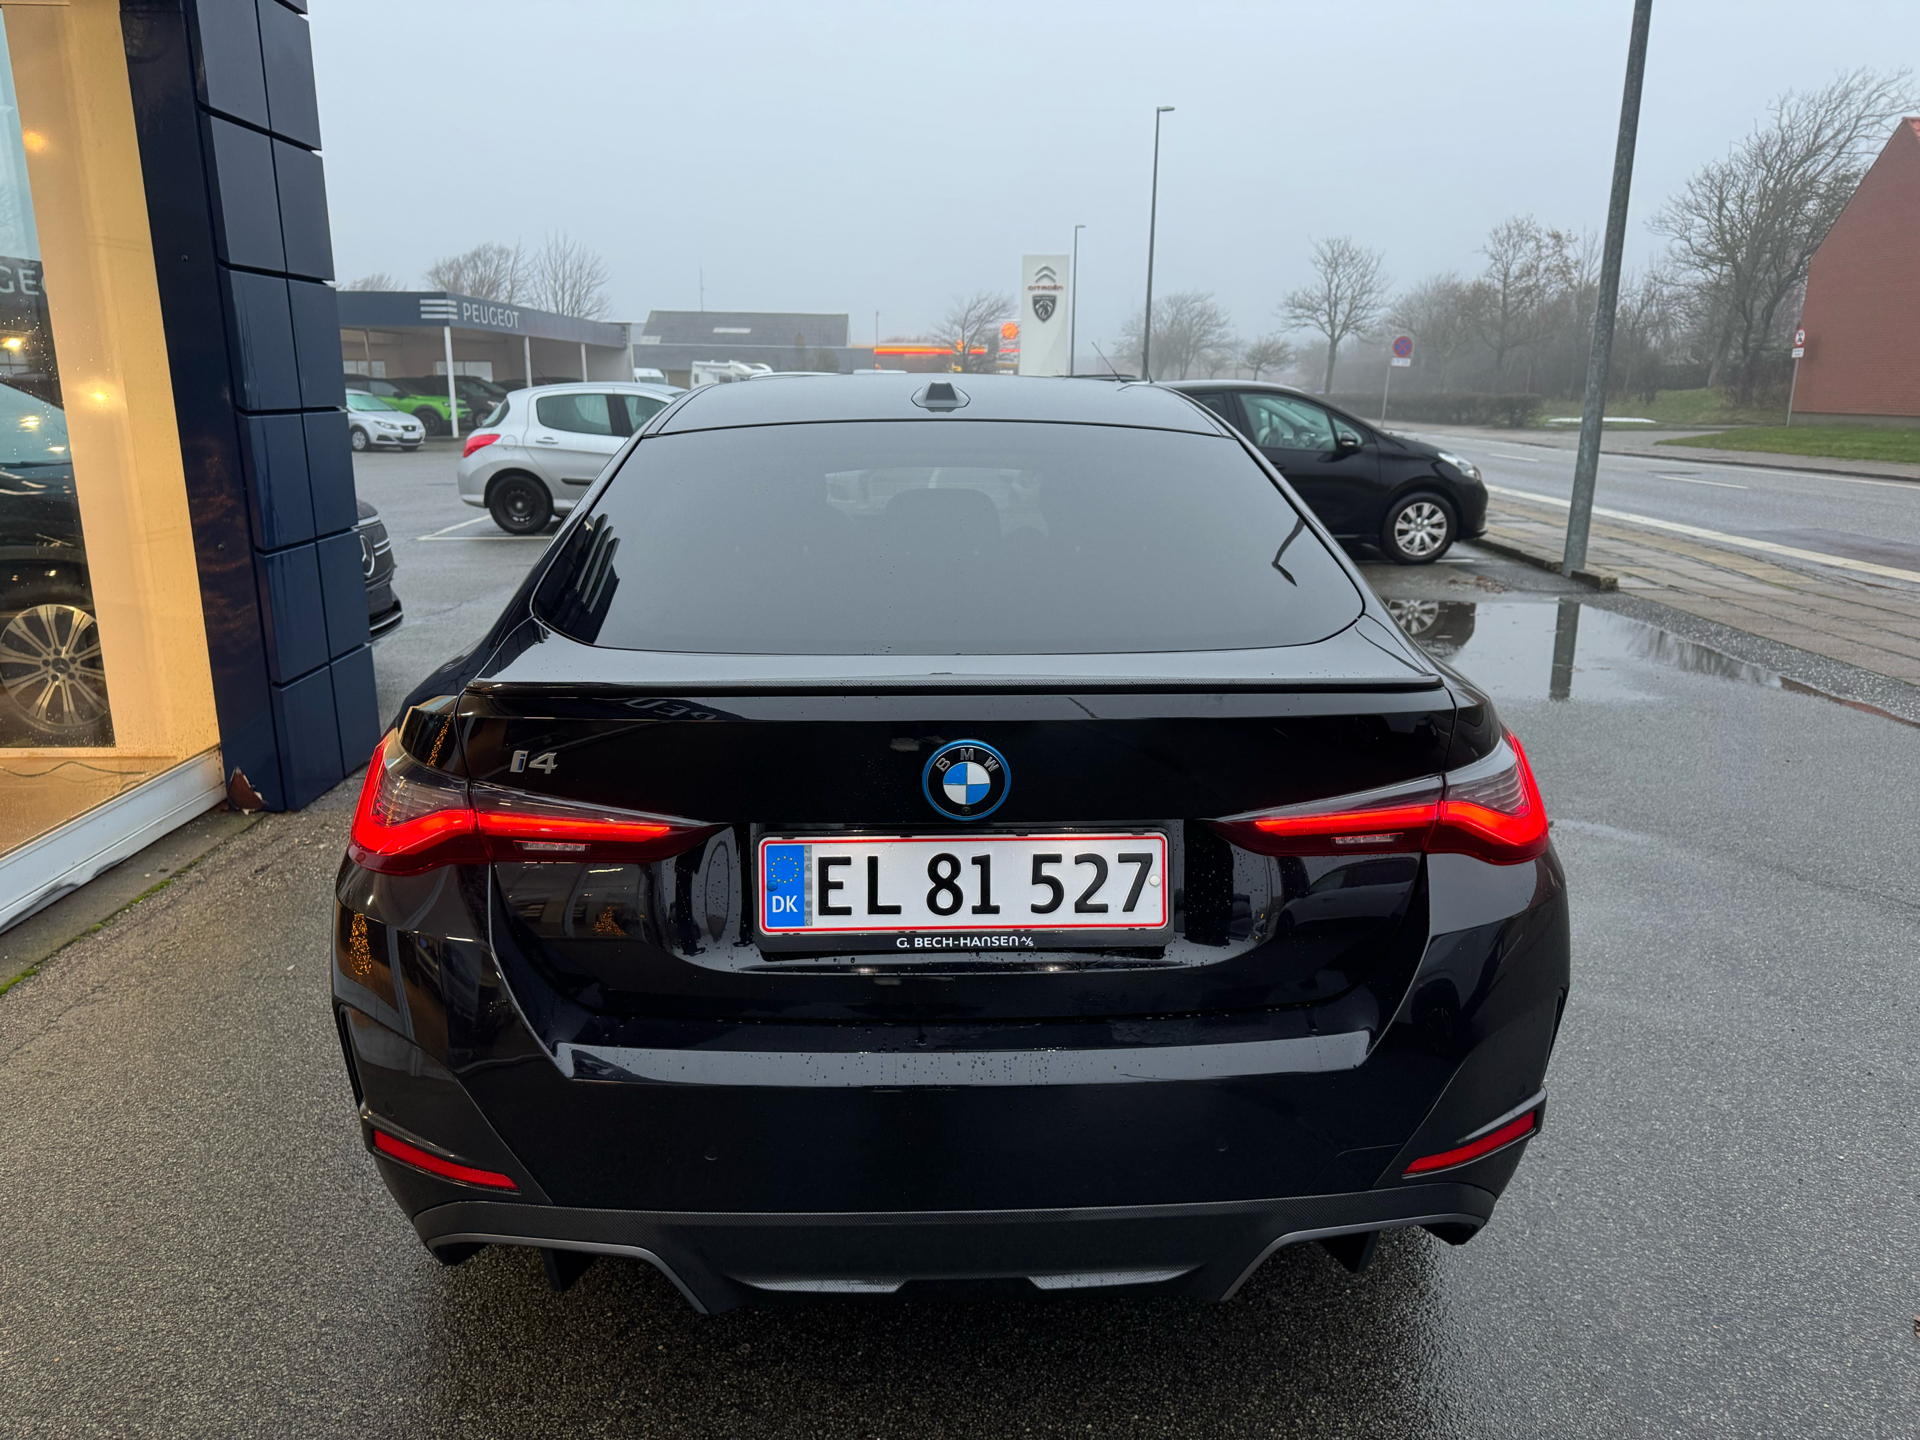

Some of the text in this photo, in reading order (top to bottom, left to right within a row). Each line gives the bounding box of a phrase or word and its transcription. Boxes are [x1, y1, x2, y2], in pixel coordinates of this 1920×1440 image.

[0, 265, 47, 295] GE
[463, 302, 519, 329] PEUGEOT
[509, 749, 558, 775] i4
[935, 748, 1000, 773] BMW
[818, 852, 1153, 916] EL 81 527
[772, 895, 798, 913] DK
[896, 937, 910, 948] G.
